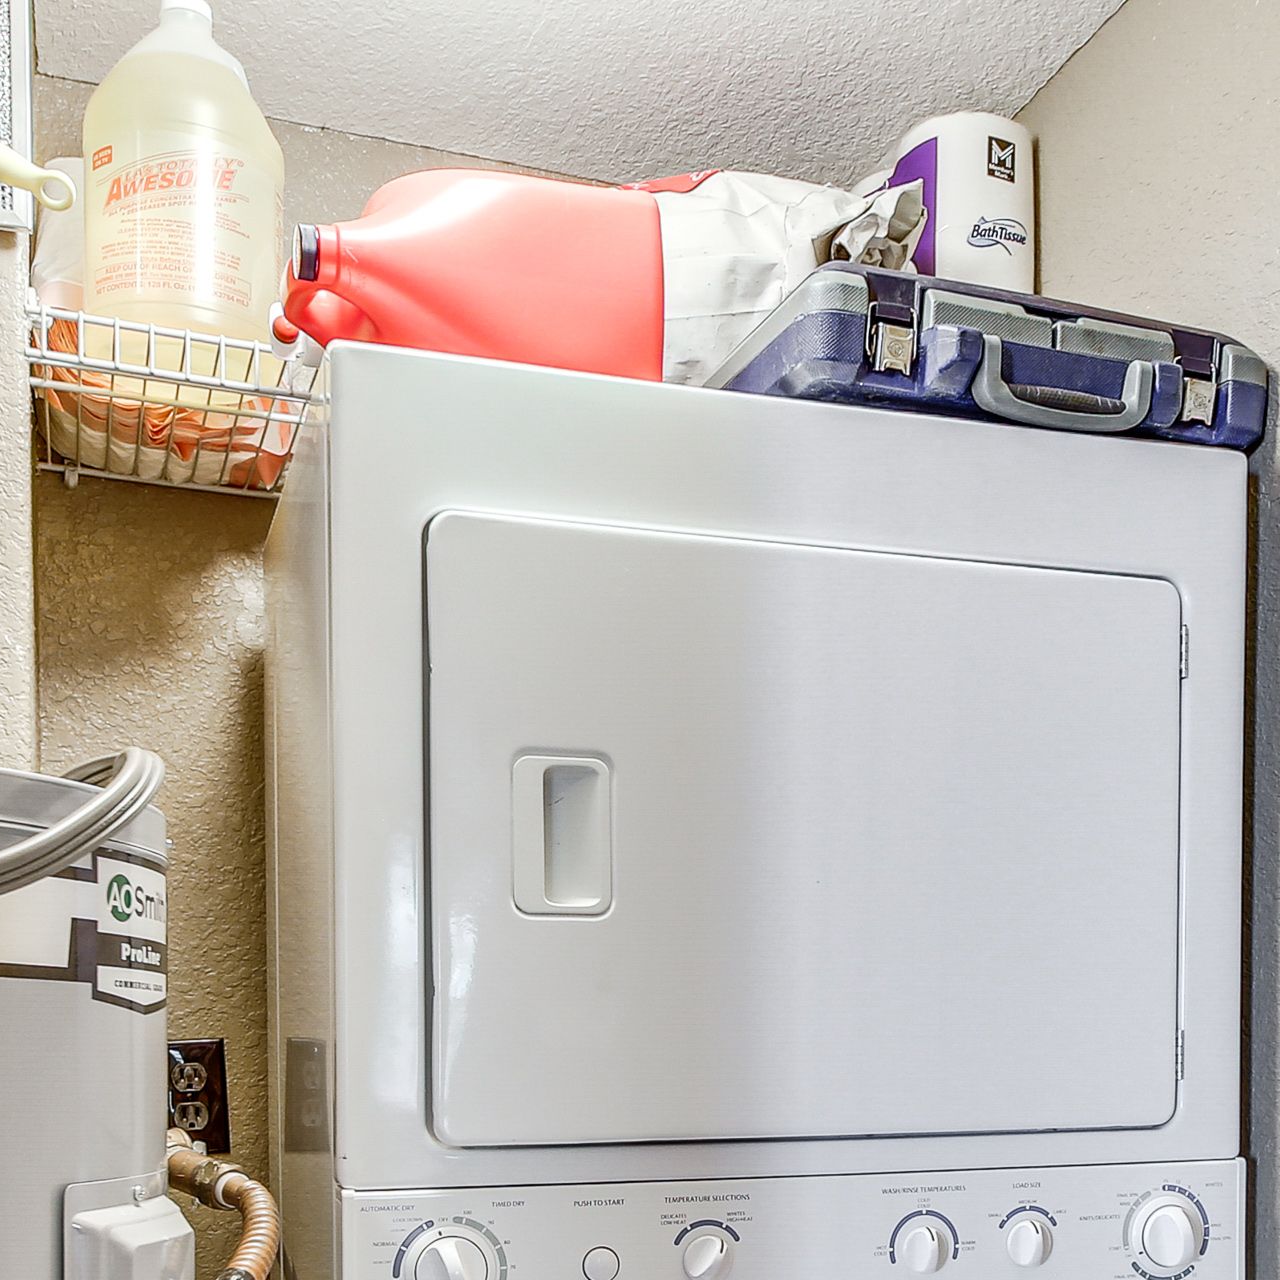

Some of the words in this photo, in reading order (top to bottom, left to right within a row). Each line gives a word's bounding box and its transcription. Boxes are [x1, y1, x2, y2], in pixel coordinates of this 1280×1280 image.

[920, 1185, 966, 1194] TEMPERATURES
[664, 1195, 711, 1204] TEMPERATURE
[712, 1193, 750, 1202] SELECTIONS
[360, 1205, 401, 1213] AUTOMATIC
